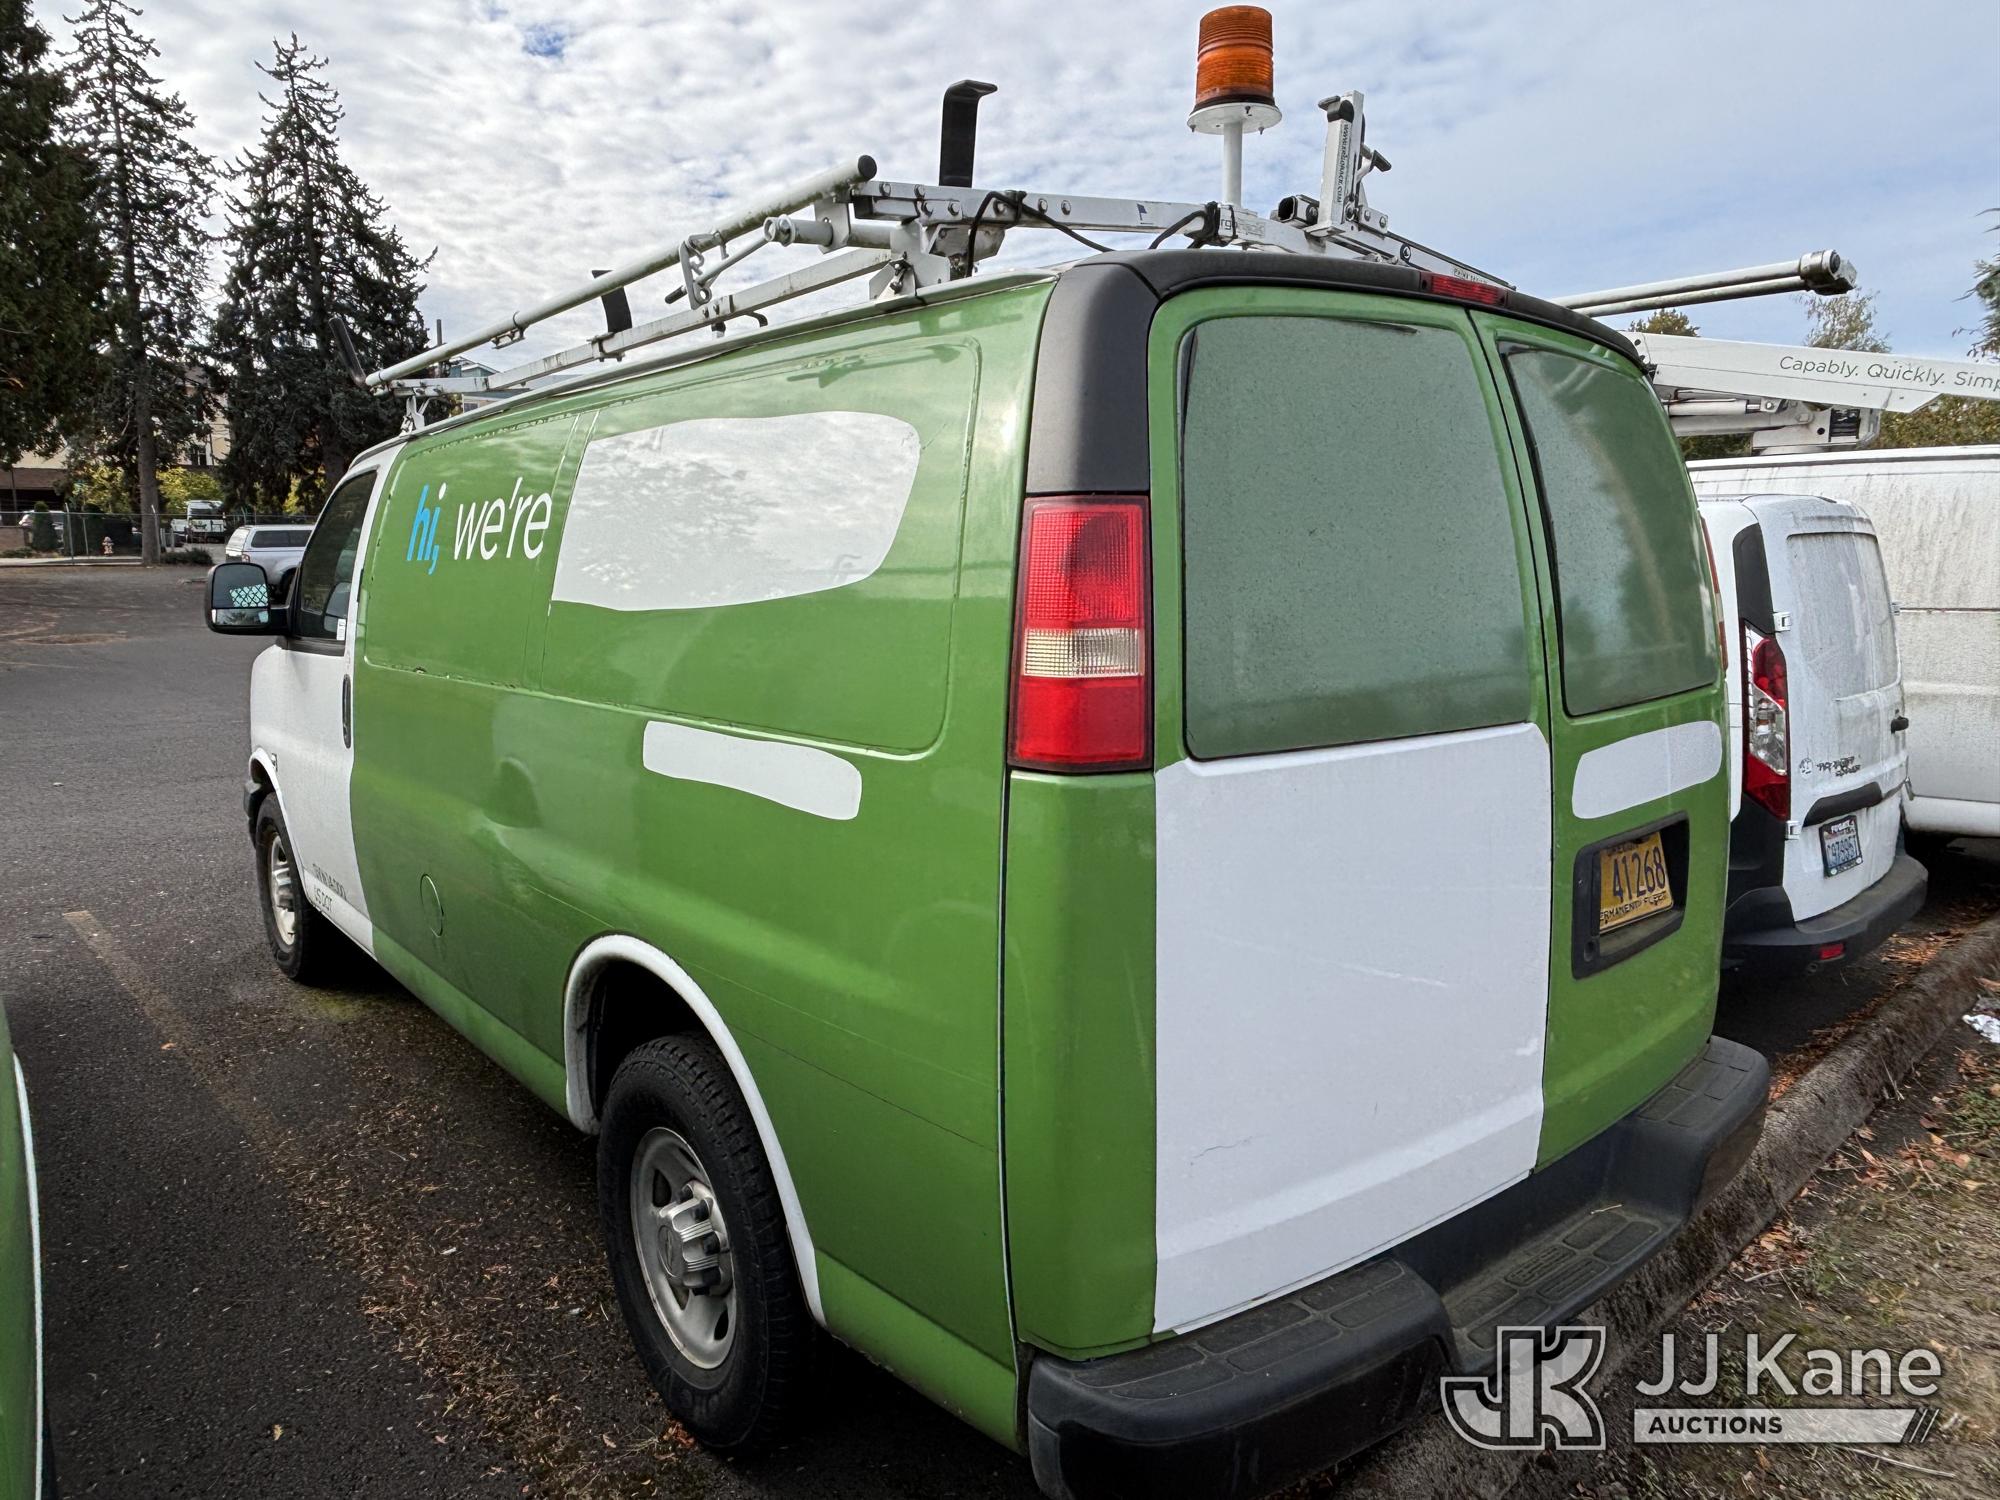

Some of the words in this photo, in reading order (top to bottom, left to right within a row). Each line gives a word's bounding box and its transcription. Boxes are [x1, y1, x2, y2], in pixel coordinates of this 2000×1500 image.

[1779, 355, 1859, 378] Capably.
[1867, 362, 1945, 386] Quickly.
[406, 482, 447, 576] hi,
[453, 476, 553, 560] we're
[1613, 846, 1666, 903] 41268
[1599, 900, 1642, 920] ERMANENT
